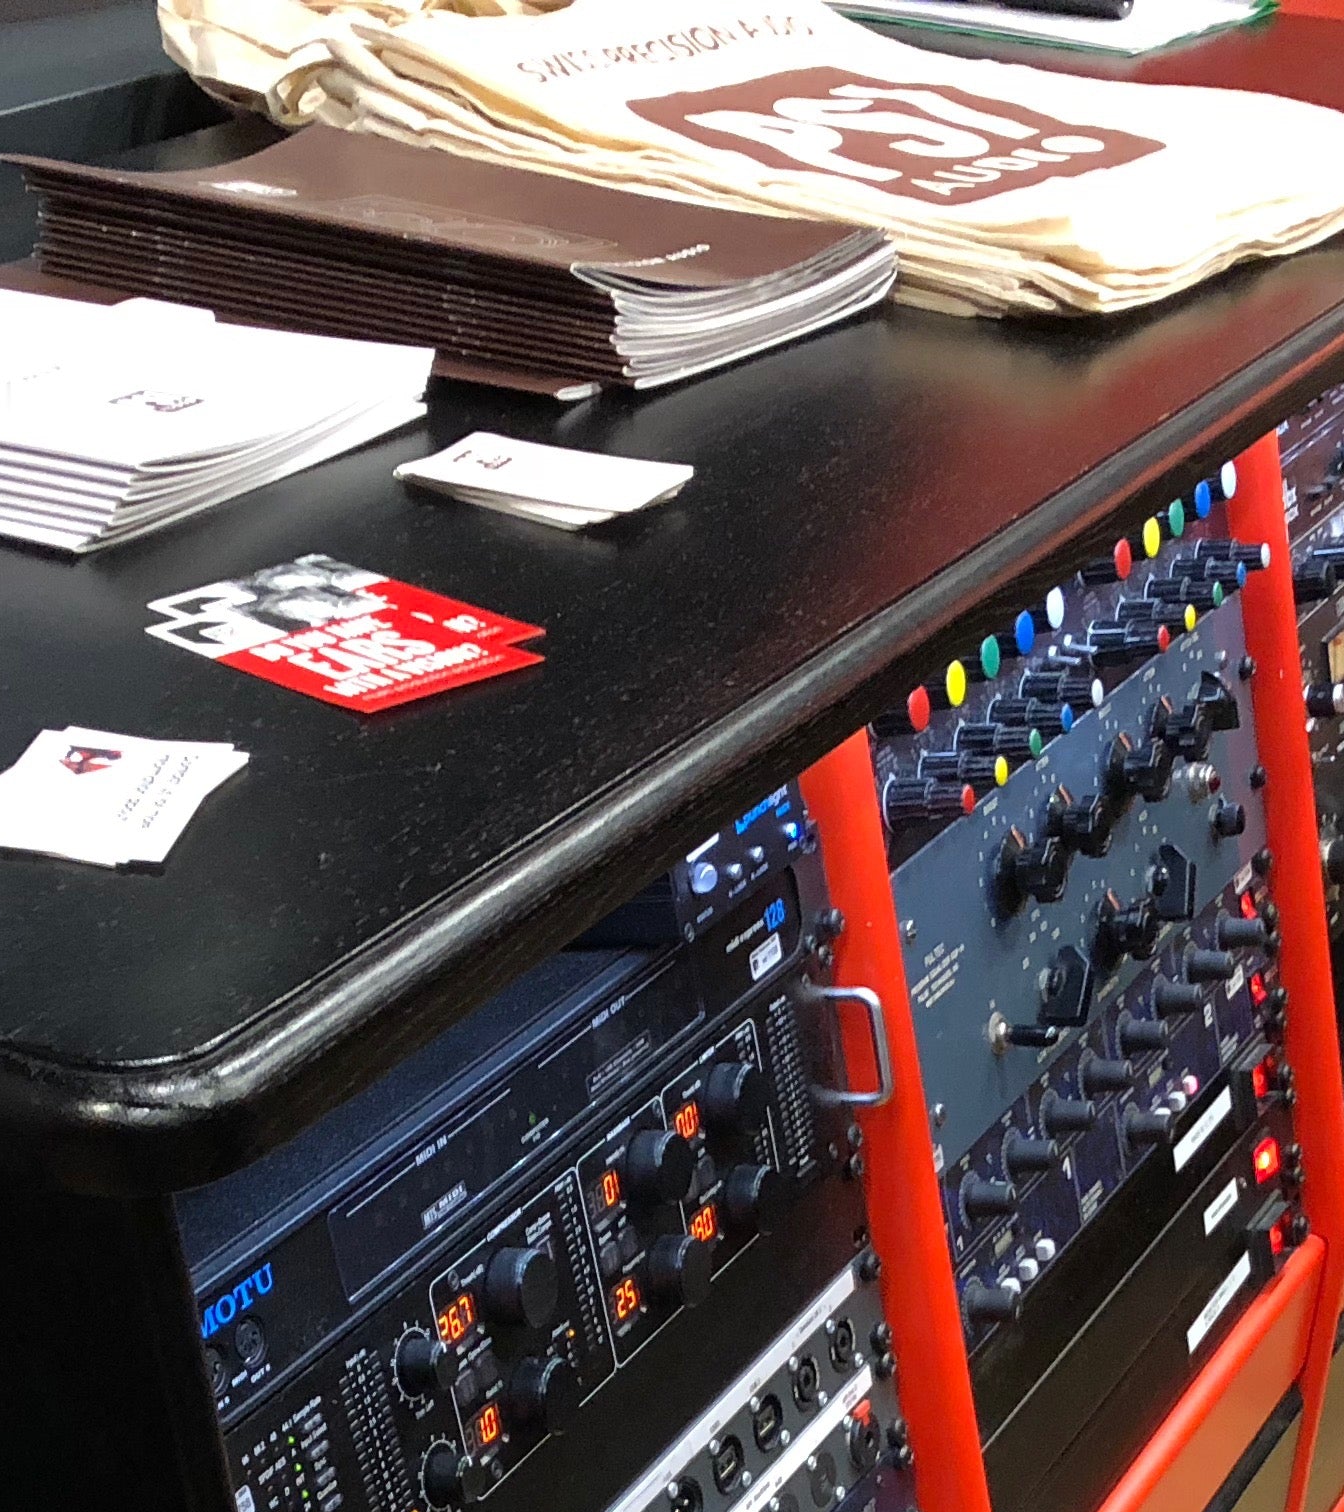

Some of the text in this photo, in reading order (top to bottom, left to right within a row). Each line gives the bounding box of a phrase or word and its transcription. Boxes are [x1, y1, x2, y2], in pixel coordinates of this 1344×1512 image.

[911, 135, 1105, 195] AUDIO
[287, 631, 435, 680] EARS
[764, 898, 786, 931] 128
[609, 995, 625, 1015] OUT
[415, 1134, 447, 1167] MIDI IN
[199, 1262, 274, 1340] MOTU
[613, 1278, 637, 1318] 25
